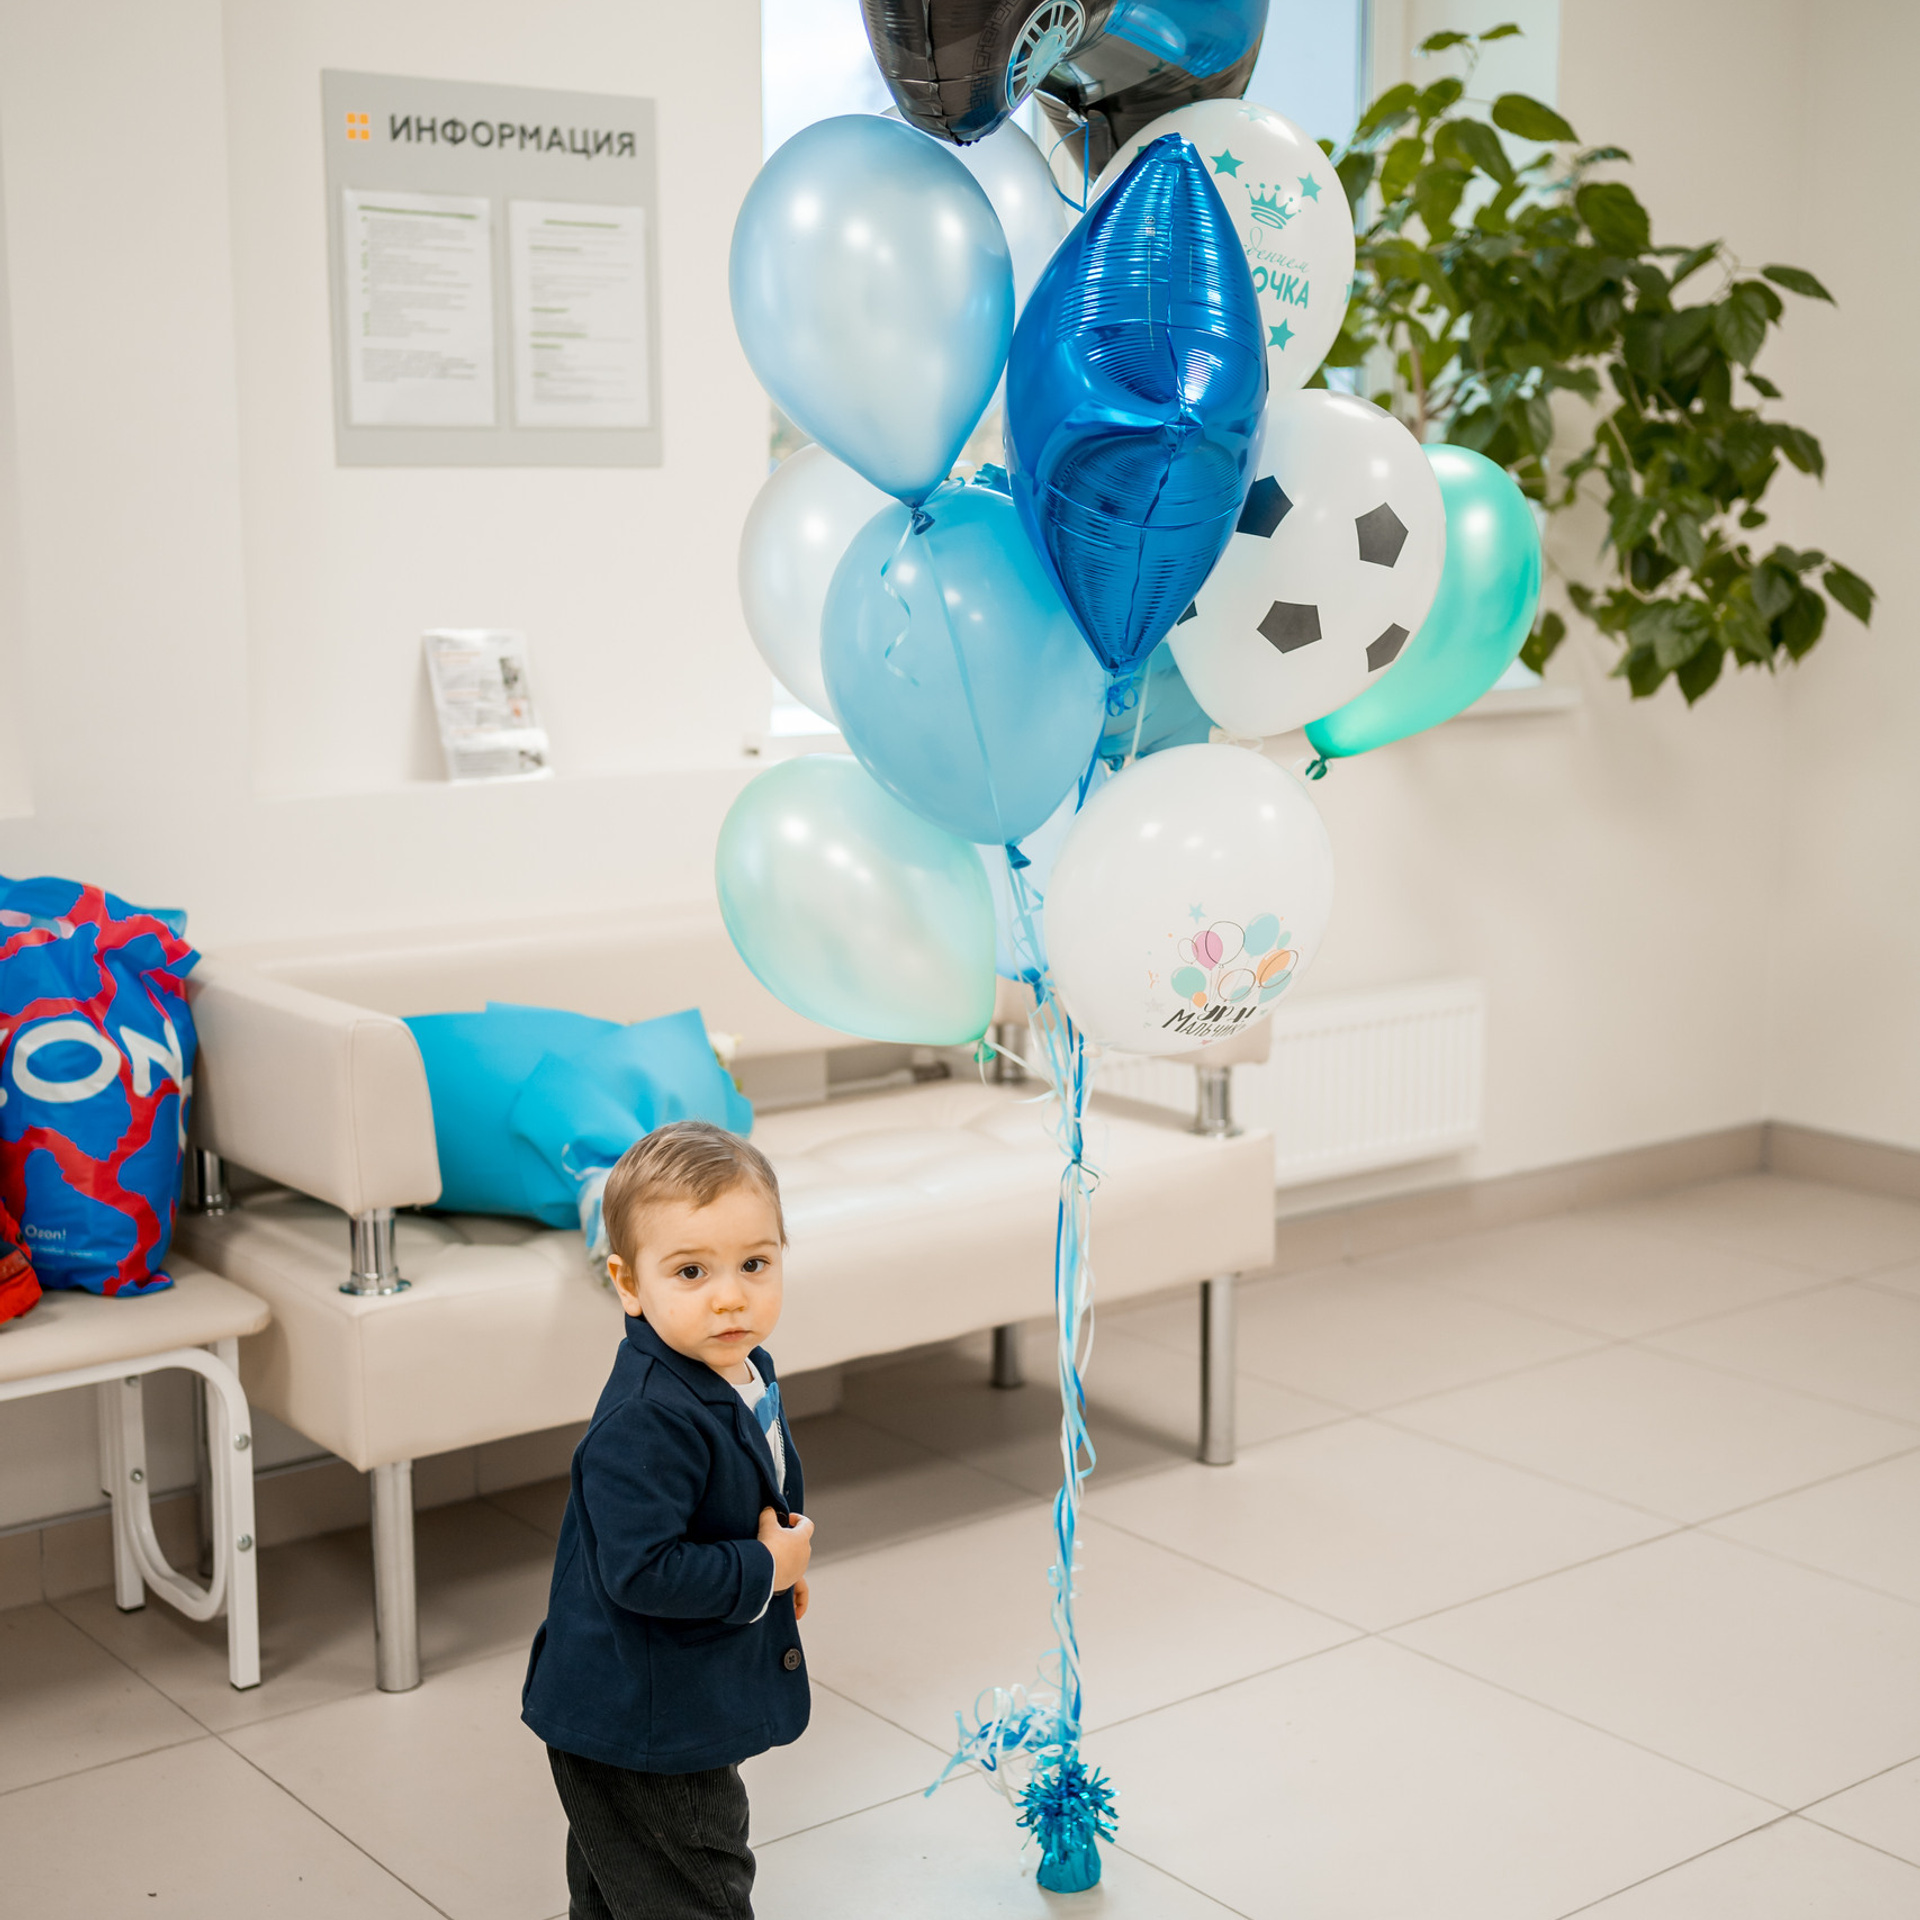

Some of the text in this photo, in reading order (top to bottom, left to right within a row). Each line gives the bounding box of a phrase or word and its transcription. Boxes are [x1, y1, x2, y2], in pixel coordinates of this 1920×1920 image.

[389, 114, 637, 161] ИНФОРМАЦИЯ
[1244, 226, 1309, 274] дением
[1251, 265, 1309, 310] ОЧКА
[0, 1019, 184, 1104] ON
